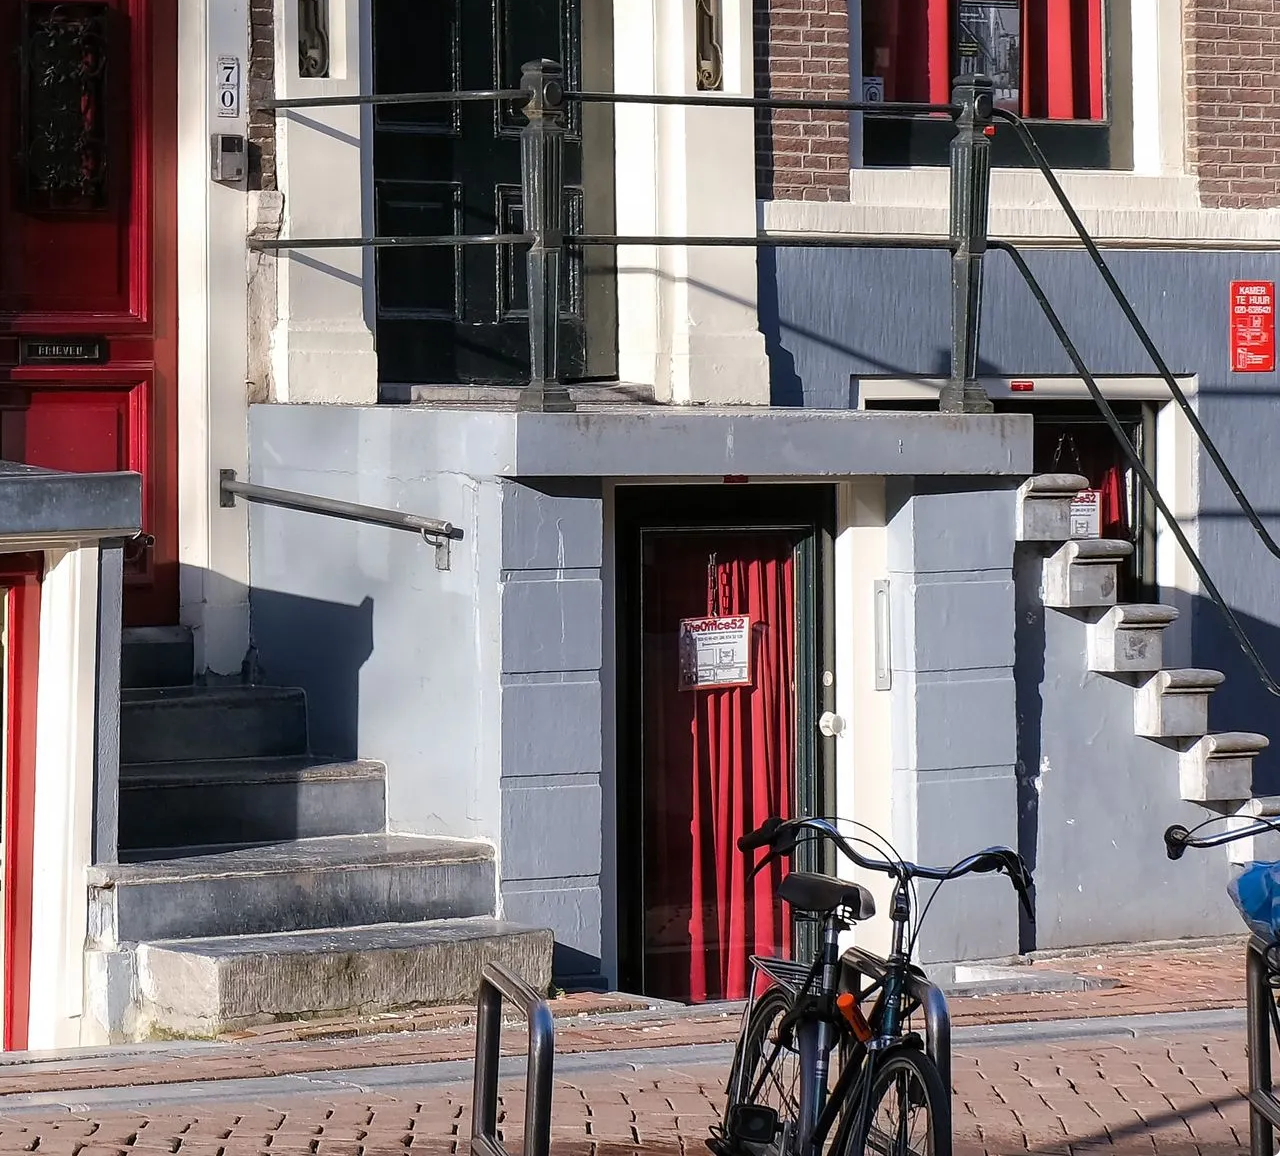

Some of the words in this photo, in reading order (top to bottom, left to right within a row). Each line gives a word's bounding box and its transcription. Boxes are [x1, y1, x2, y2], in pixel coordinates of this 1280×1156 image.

[1239, 286, 1266, 295] KAMER
[1235, 295, 1247, 305] TE
[1249, 295, 1270, 305] HUUR
